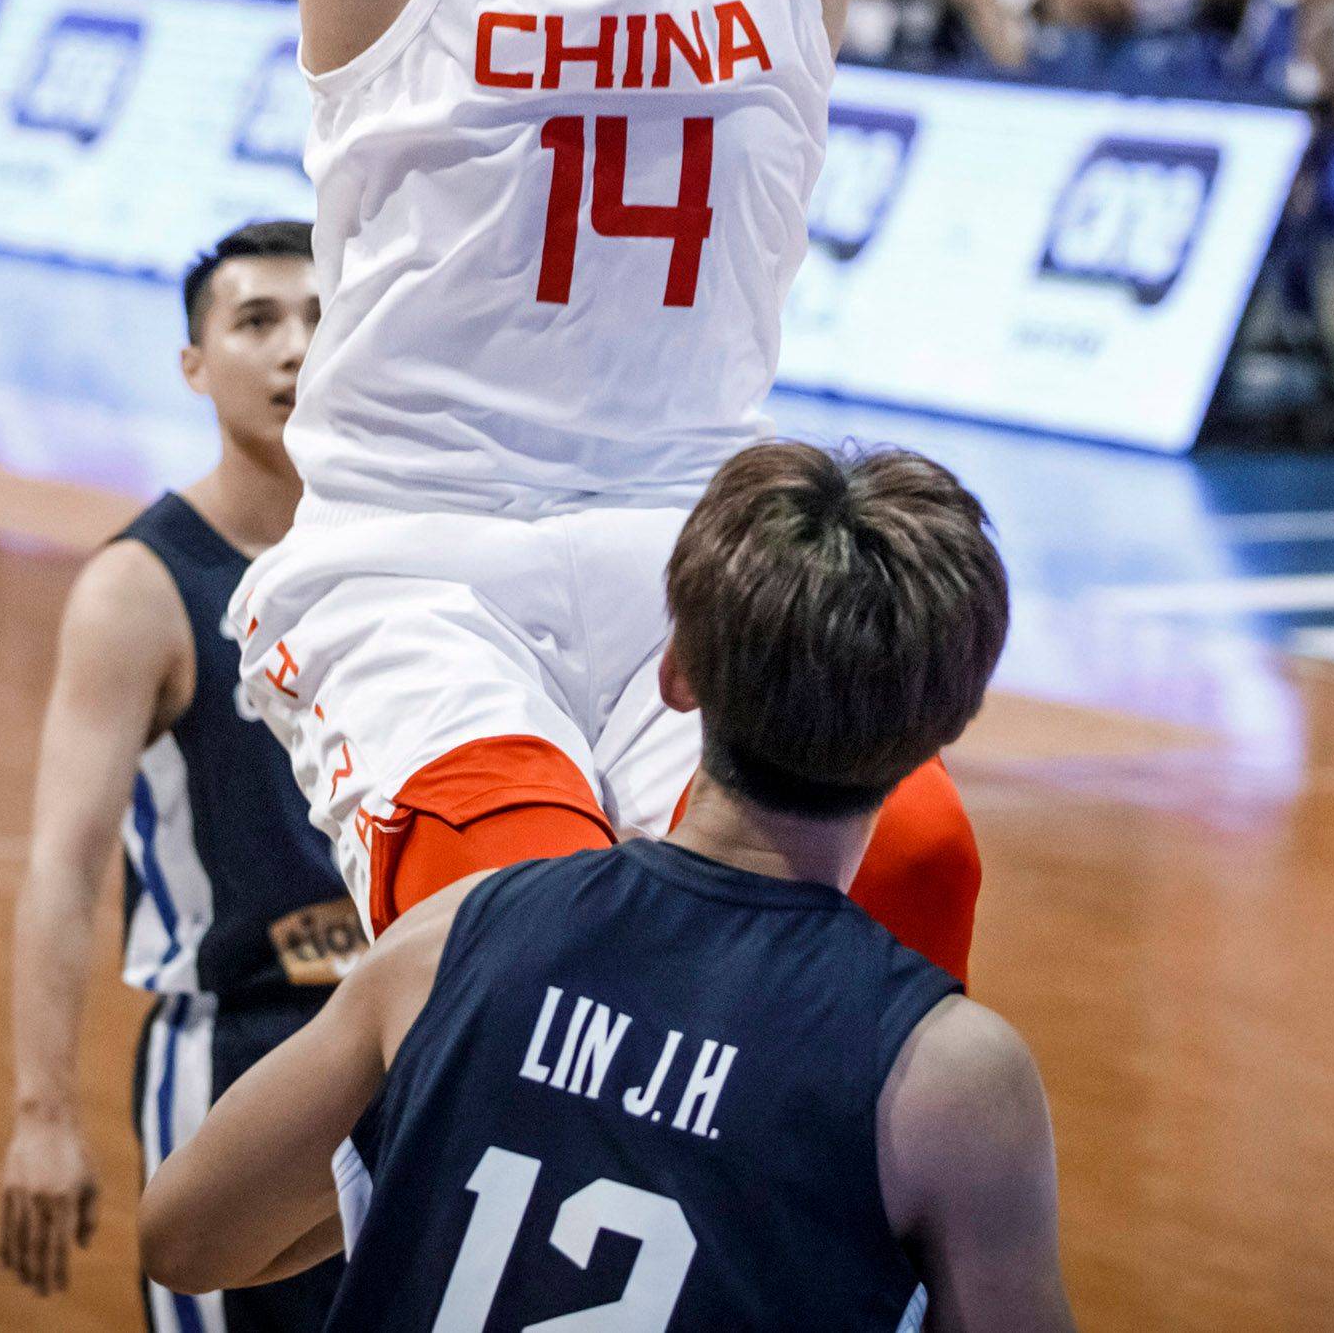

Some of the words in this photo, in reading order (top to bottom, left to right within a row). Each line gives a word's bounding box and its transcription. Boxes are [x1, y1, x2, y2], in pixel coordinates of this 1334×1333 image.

[474, 0, 773, 90] CHINA
[535, 114, 715, 308] 14
[518, 984, 634, 1100] LIN
[430, 1144, 698, 1333] 12
